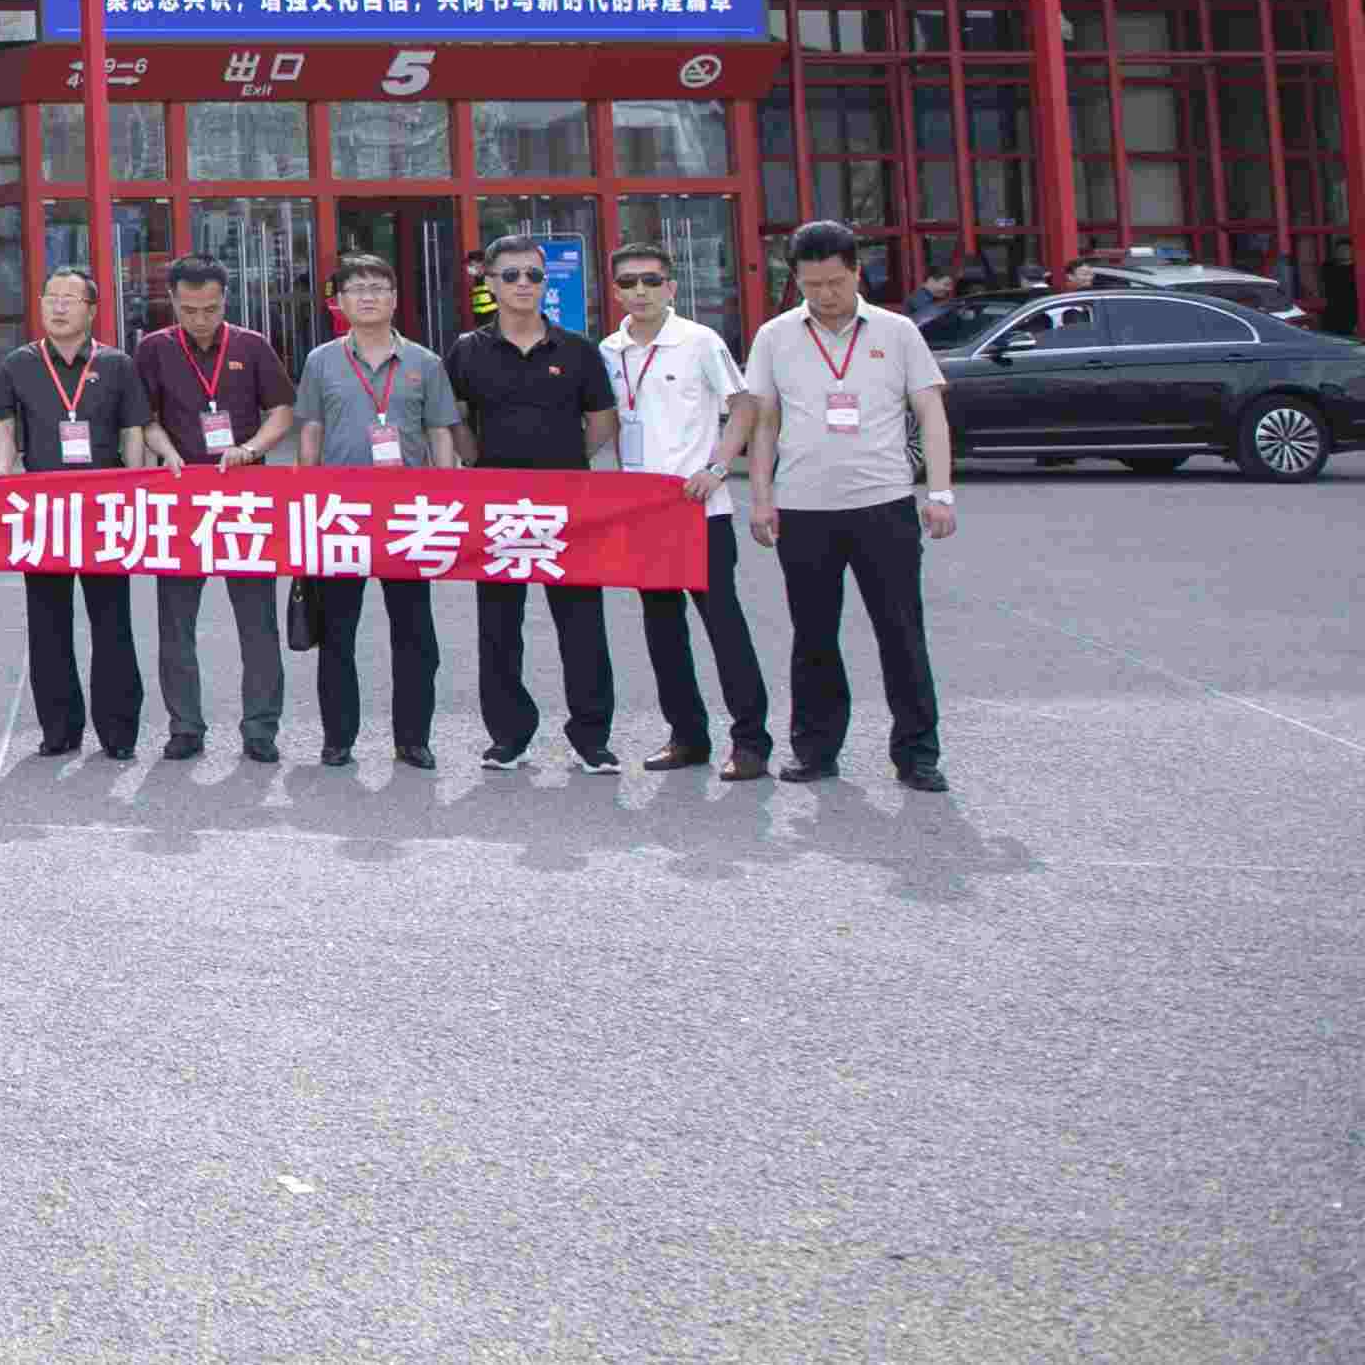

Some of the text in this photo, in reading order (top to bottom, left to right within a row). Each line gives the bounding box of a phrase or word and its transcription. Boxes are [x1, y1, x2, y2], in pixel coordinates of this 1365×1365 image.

[224, 51, 305, 82] 出口
[381, 50, 436, 96] 5
[241, 83, 273, 97] Exit
